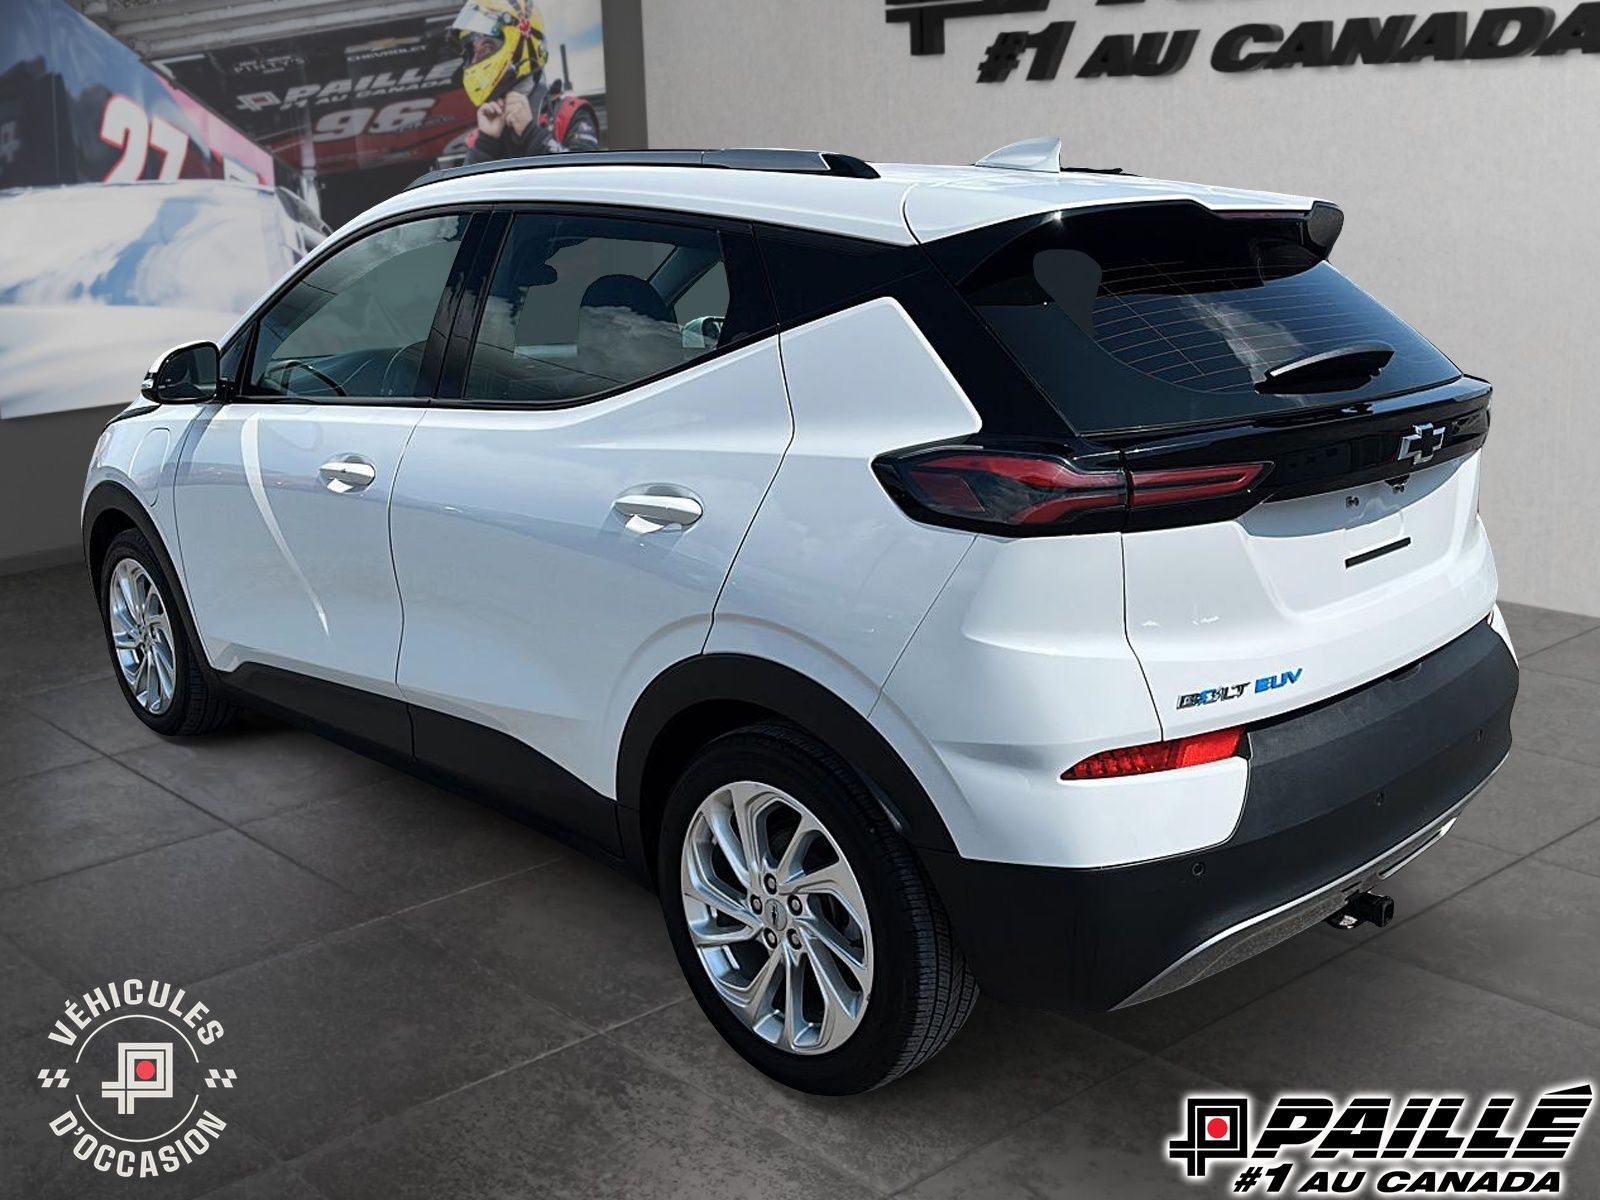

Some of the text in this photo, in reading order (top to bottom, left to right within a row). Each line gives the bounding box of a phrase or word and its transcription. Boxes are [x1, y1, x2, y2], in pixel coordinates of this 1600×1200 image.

[976, 1, 1600, 84] #1 AU CANADA
[99, 92, 190, 184] 27
[313, 98, 436, 142] 96
[1254, 668, 1303, 694] EUV
